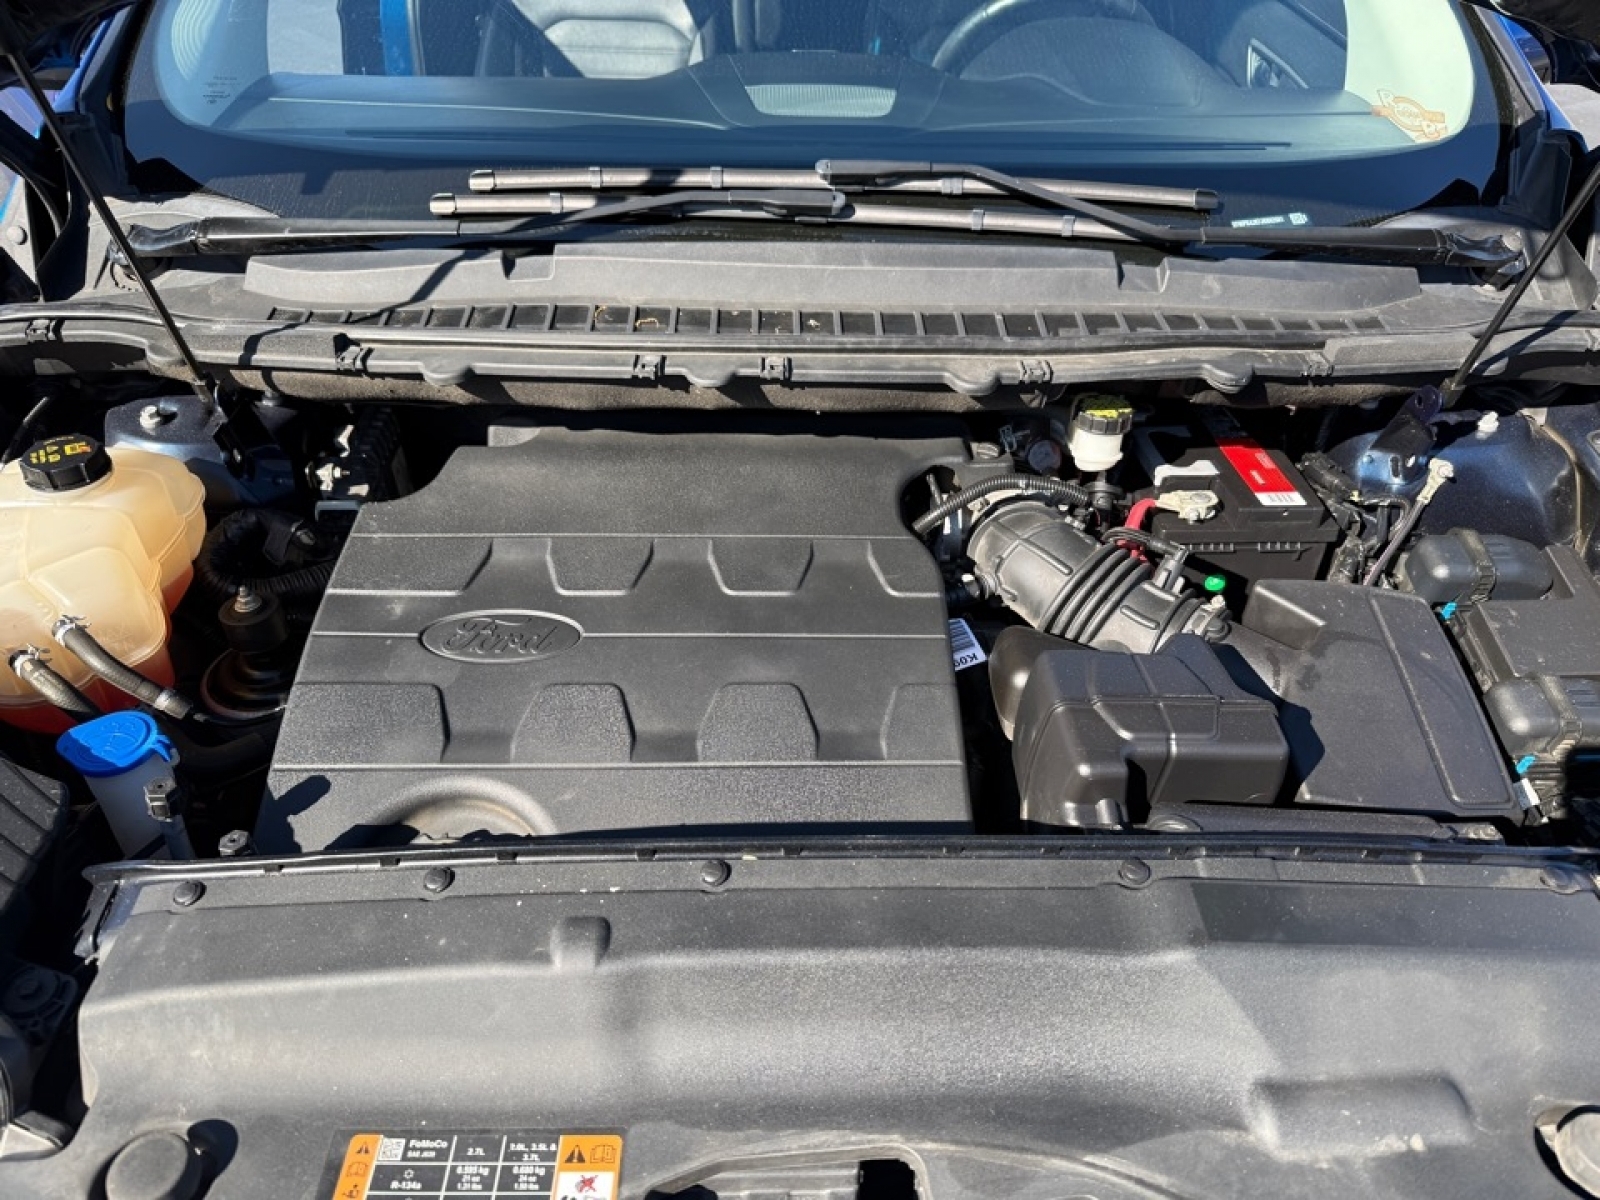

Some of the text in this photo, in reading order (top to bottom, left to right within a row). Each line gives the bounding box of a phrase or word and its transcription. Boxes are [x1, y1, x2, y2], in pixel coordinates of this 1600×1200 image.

[440, 617, 557, 655] Ford
[409, 1139, 448, 1148] FoMoCo
[467, 1148, 485, 1156] 2.7L
[478, 1165, 490, 1176] kg
[534, 1165, 546, 1176] kg
[390, 1181, 422, 1190] R-134a
